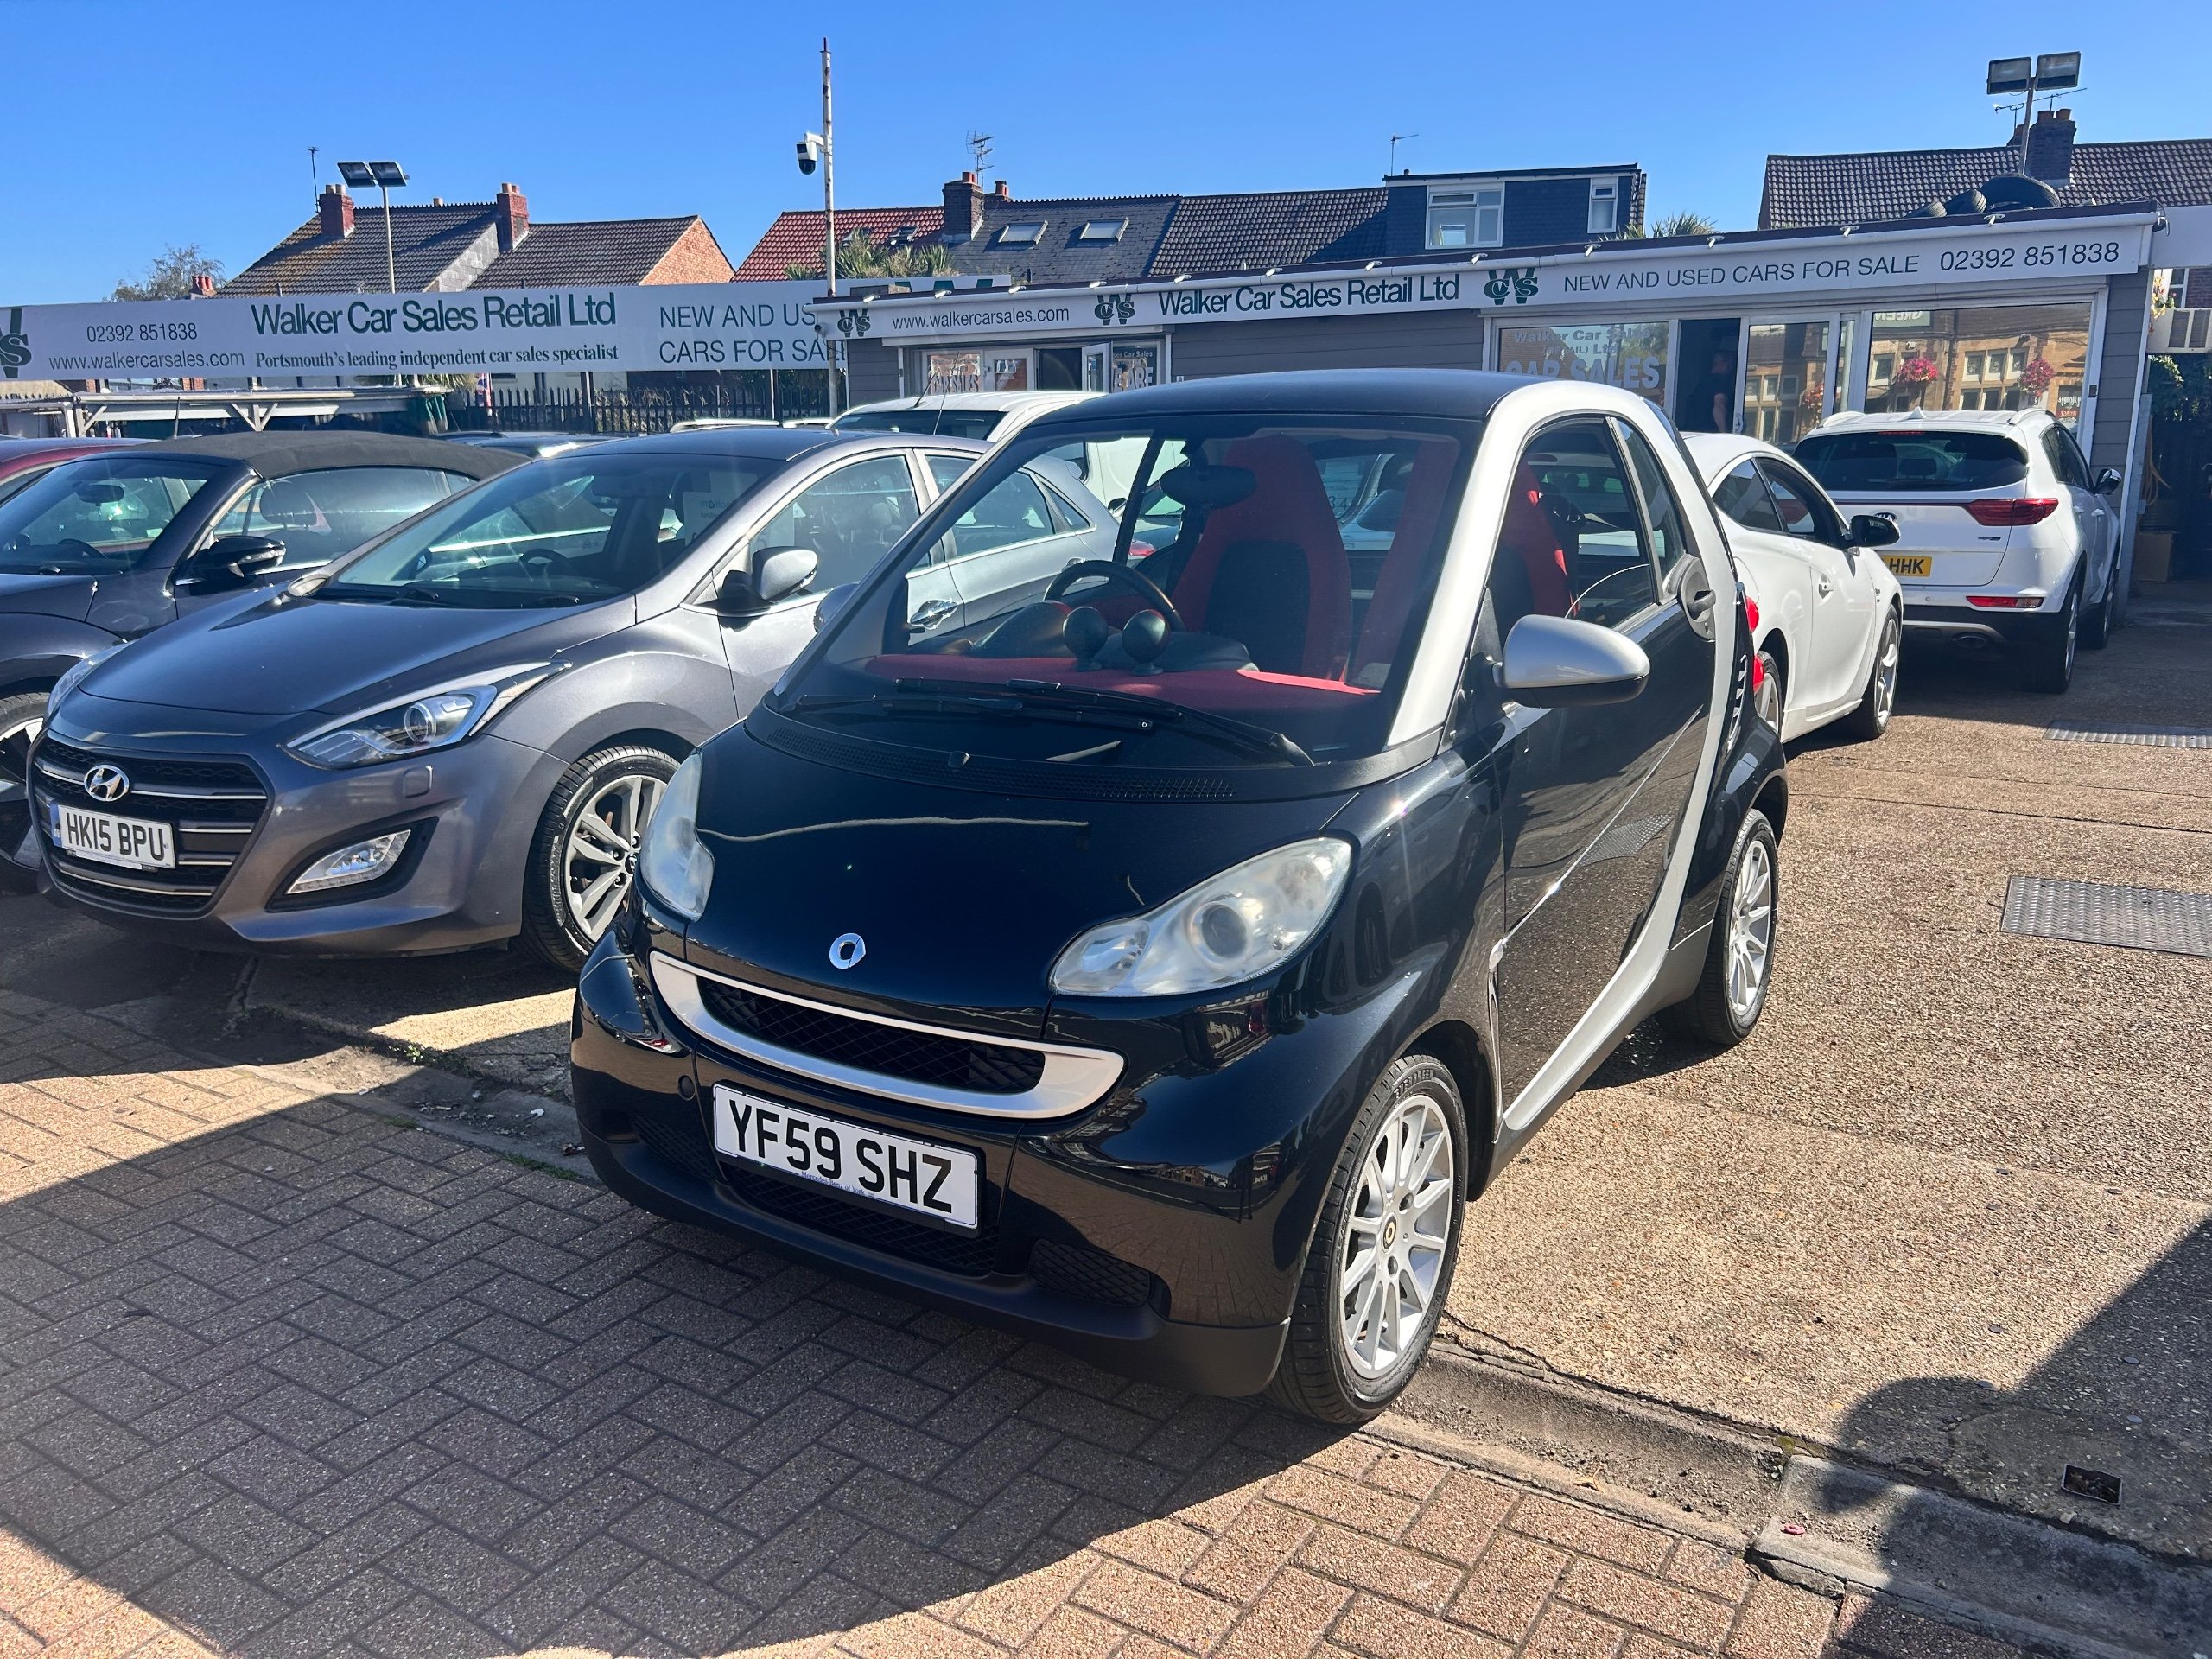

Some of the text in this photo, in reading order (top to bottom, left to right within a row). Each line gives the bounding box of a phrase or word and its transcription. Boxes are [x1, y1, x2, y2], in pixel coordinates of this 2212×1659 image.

[1564, 241, 2120, 293] NEW AND USED CARS FOR SALE 02392 851838
[1158, 273, 1459, 315] Walker Car Sales Retail Ltd
[251, 291, 616, 335] Walker Car Sales Retail Ltd
[660, 303, 815, 328] NEW AND US
[892, 307, 1070, 330] www.walkercarsales.com
[87, 321, 198, 344] 02392 851838
[1515, 328, 1650, 344] Walker Car Sales
[49, 349, 245, 371] www.walkercarsales.com
[256, 344, 620, 371] Portsmouth's leading independent car sales specialist
[659, 340, 726, 363] CARS
[734, 340, 784, 362] FOR
[1592, 343, 1618, 355] Ltd
[1570, 356, 1660, 389] SALES
[1889, 558, 1924, 574] HHK
[67, 812, 112, 852] HK15
[118, 822, 166, 861] BPU
[729, 1099, 952, 1214] YF59 SHZ
